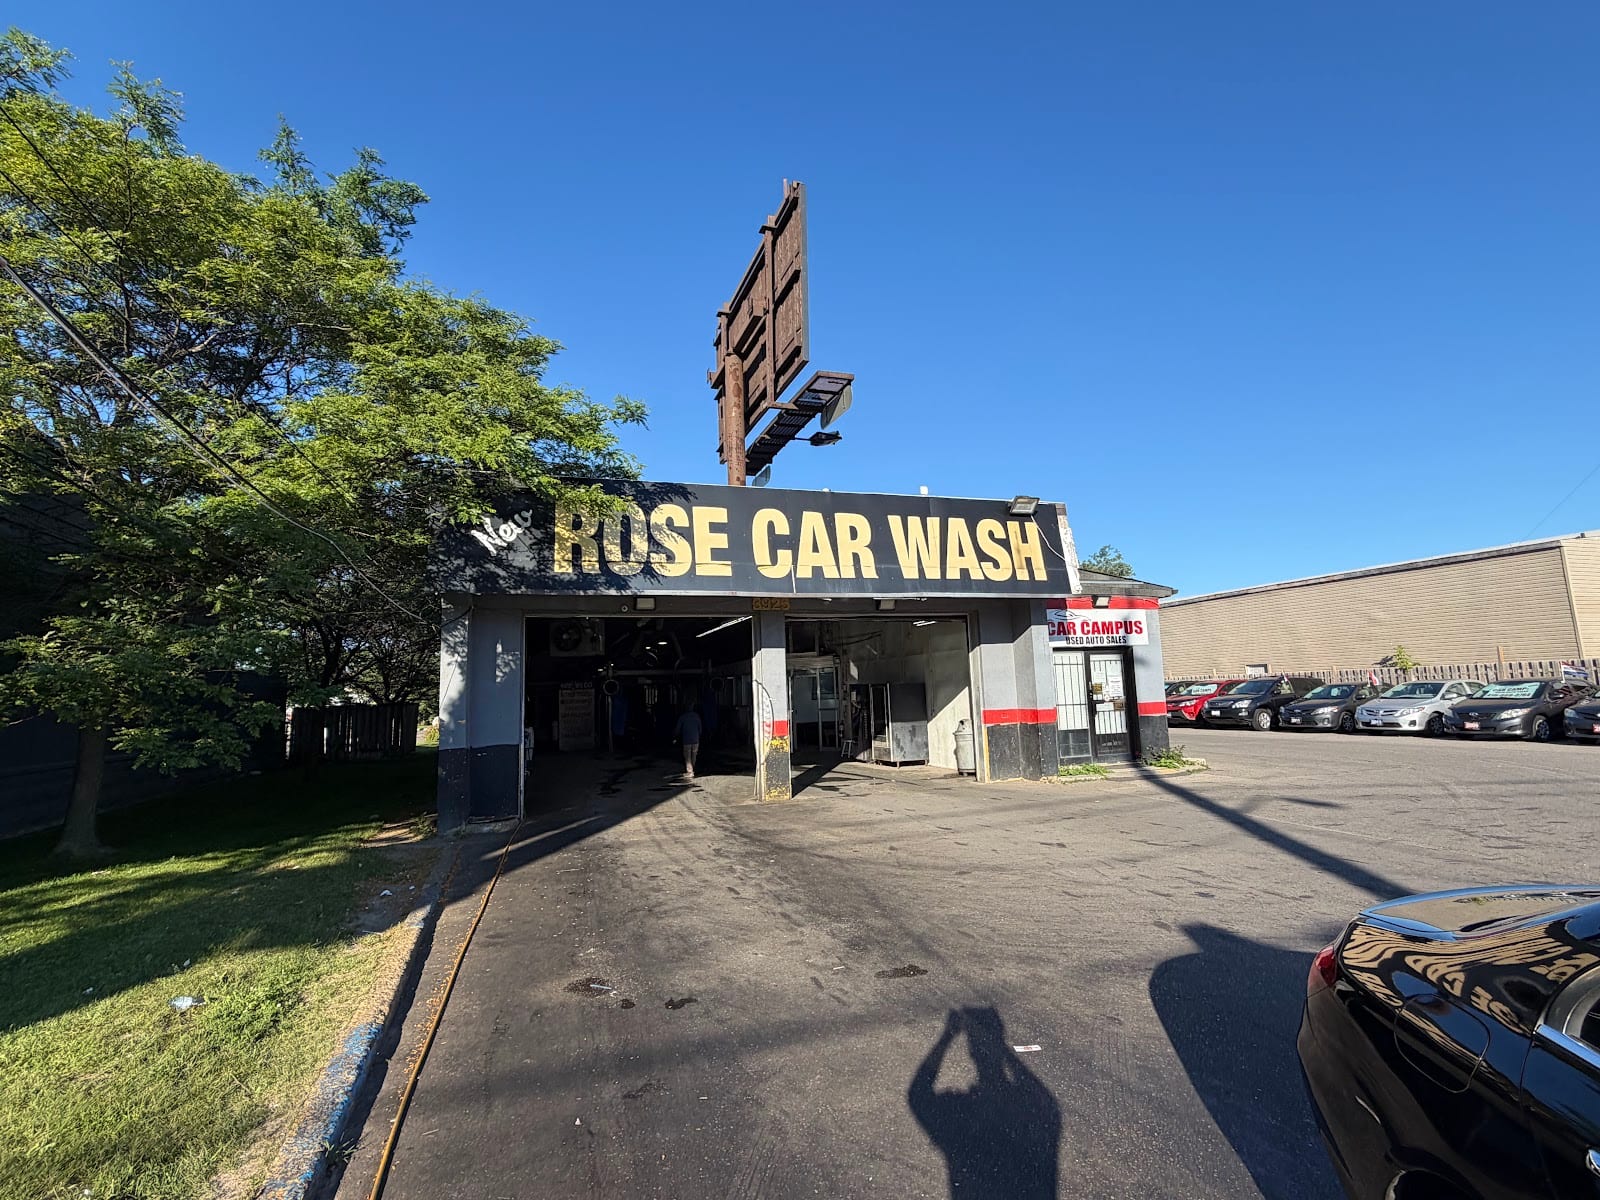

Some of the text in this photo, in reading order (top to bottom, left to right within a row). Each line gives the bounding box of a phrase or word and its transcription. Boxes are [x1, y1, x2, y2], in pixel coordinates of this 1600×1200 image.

[471, 509, 533, 556] New
[554, 499, 1048, 581] ROSE CAR WASH
[1048, 620, 1143, 636] CAR CAMPUS
[1066, 636, 1127, 645] USED AUTO SALES
